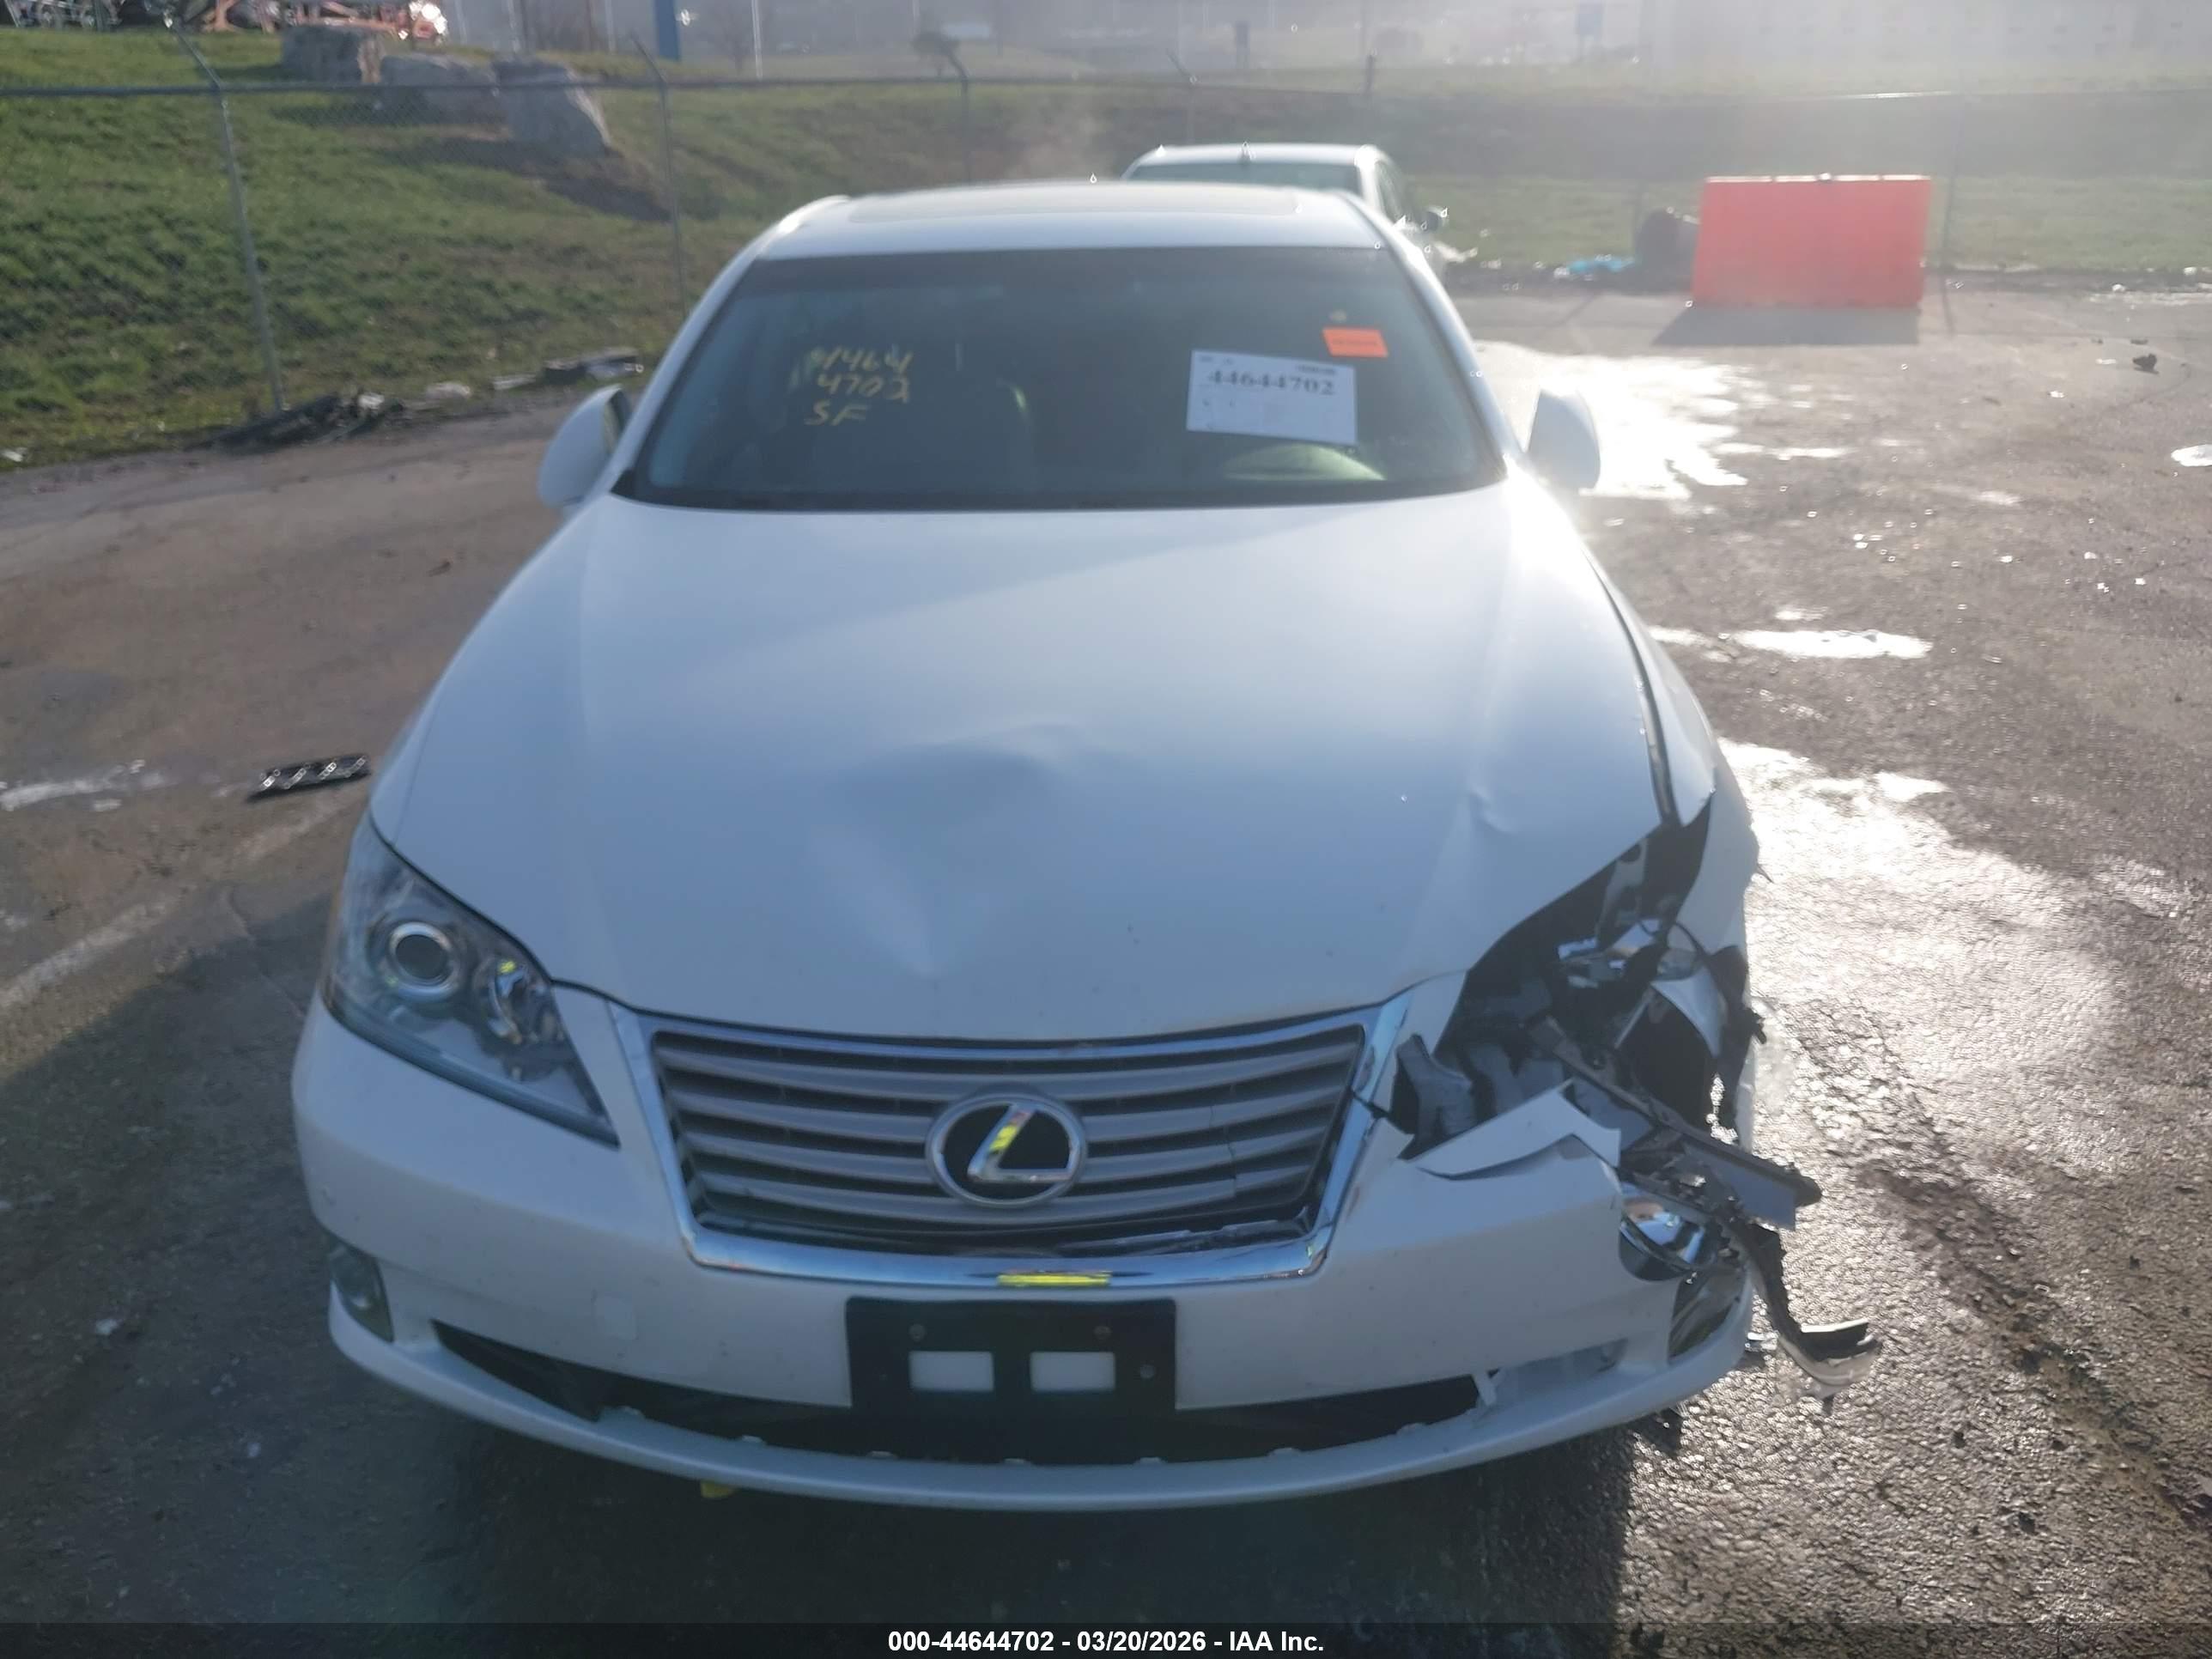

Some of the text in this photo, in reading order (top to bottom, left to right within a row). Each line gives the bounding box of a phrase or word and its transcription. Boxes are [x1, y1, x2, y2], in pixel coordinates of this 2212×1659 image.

[816, 372, 911, 404] 4702
[1206, 368, 1337, 396] 44644702
[804, 398, 872, 426] SF
